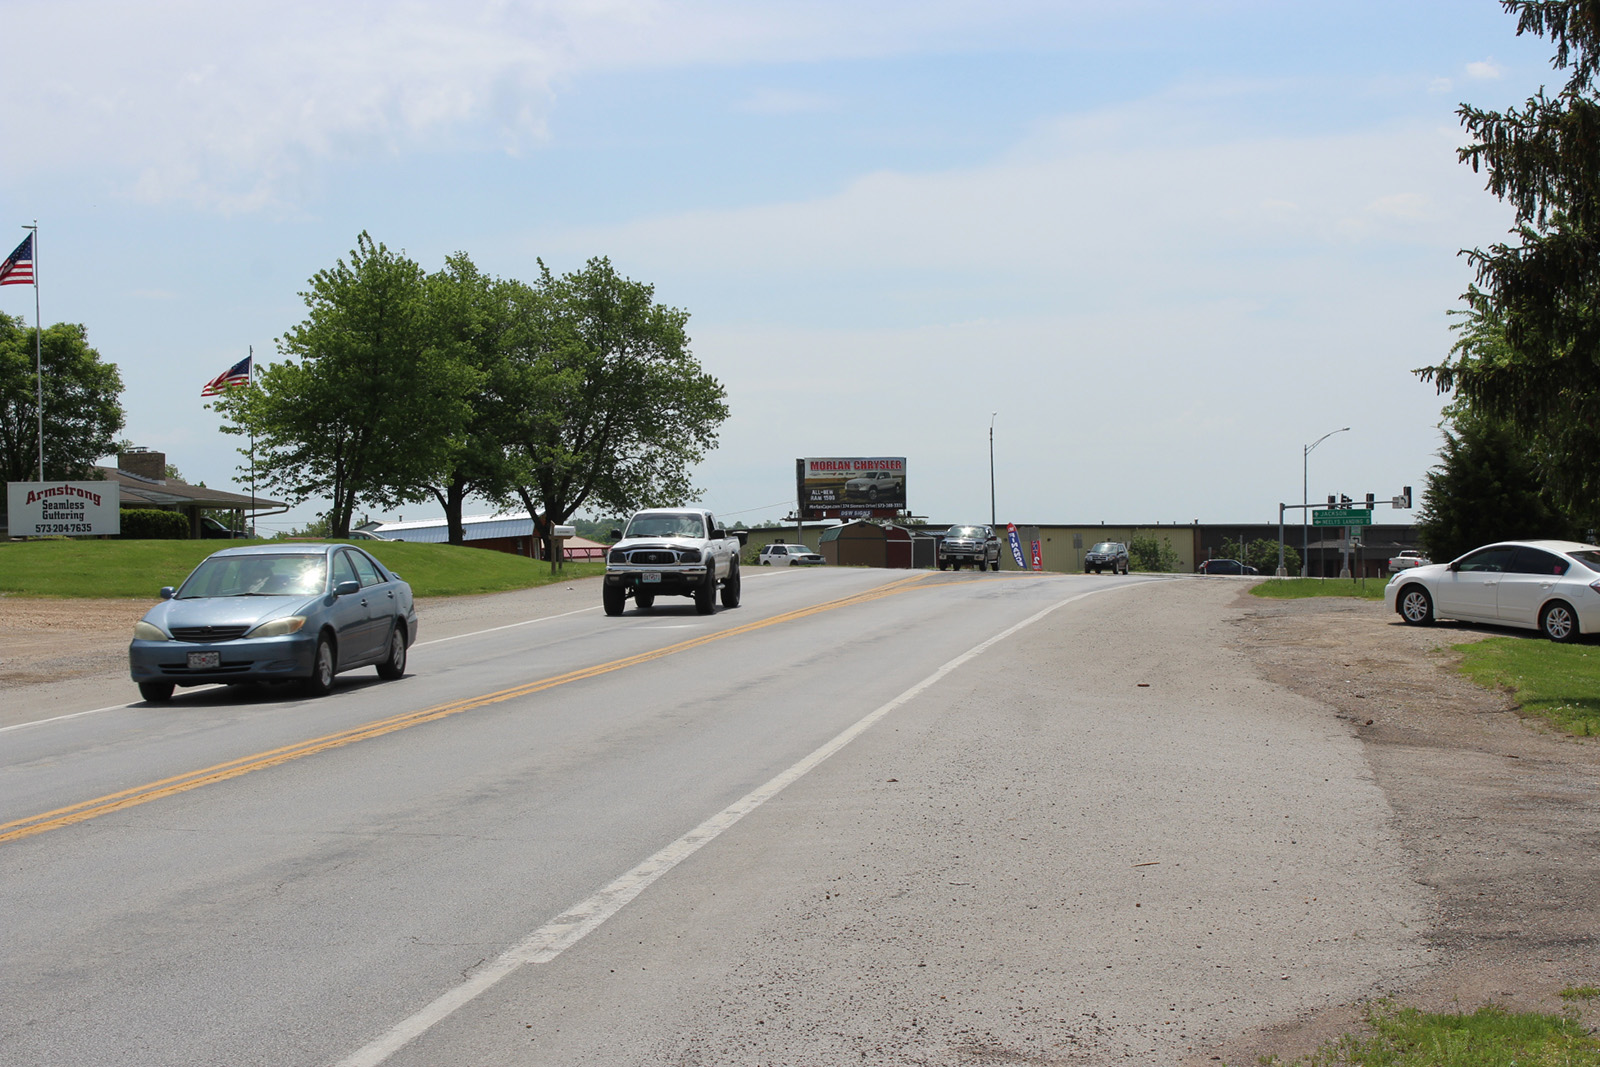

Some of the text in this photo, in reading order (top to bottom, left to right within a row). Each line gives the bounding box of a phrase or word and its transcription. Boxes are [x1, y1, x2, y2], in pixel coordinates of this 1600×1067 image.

[810, 460, 902, 470] MORLAN CHRYSLER
[25, 484, 101, 506] Armstrong
[42, 499, 85, 510] Seamless
[42, 510, 85, 521] Guttering
[35, 523, 92, 533] 573-204-7635
